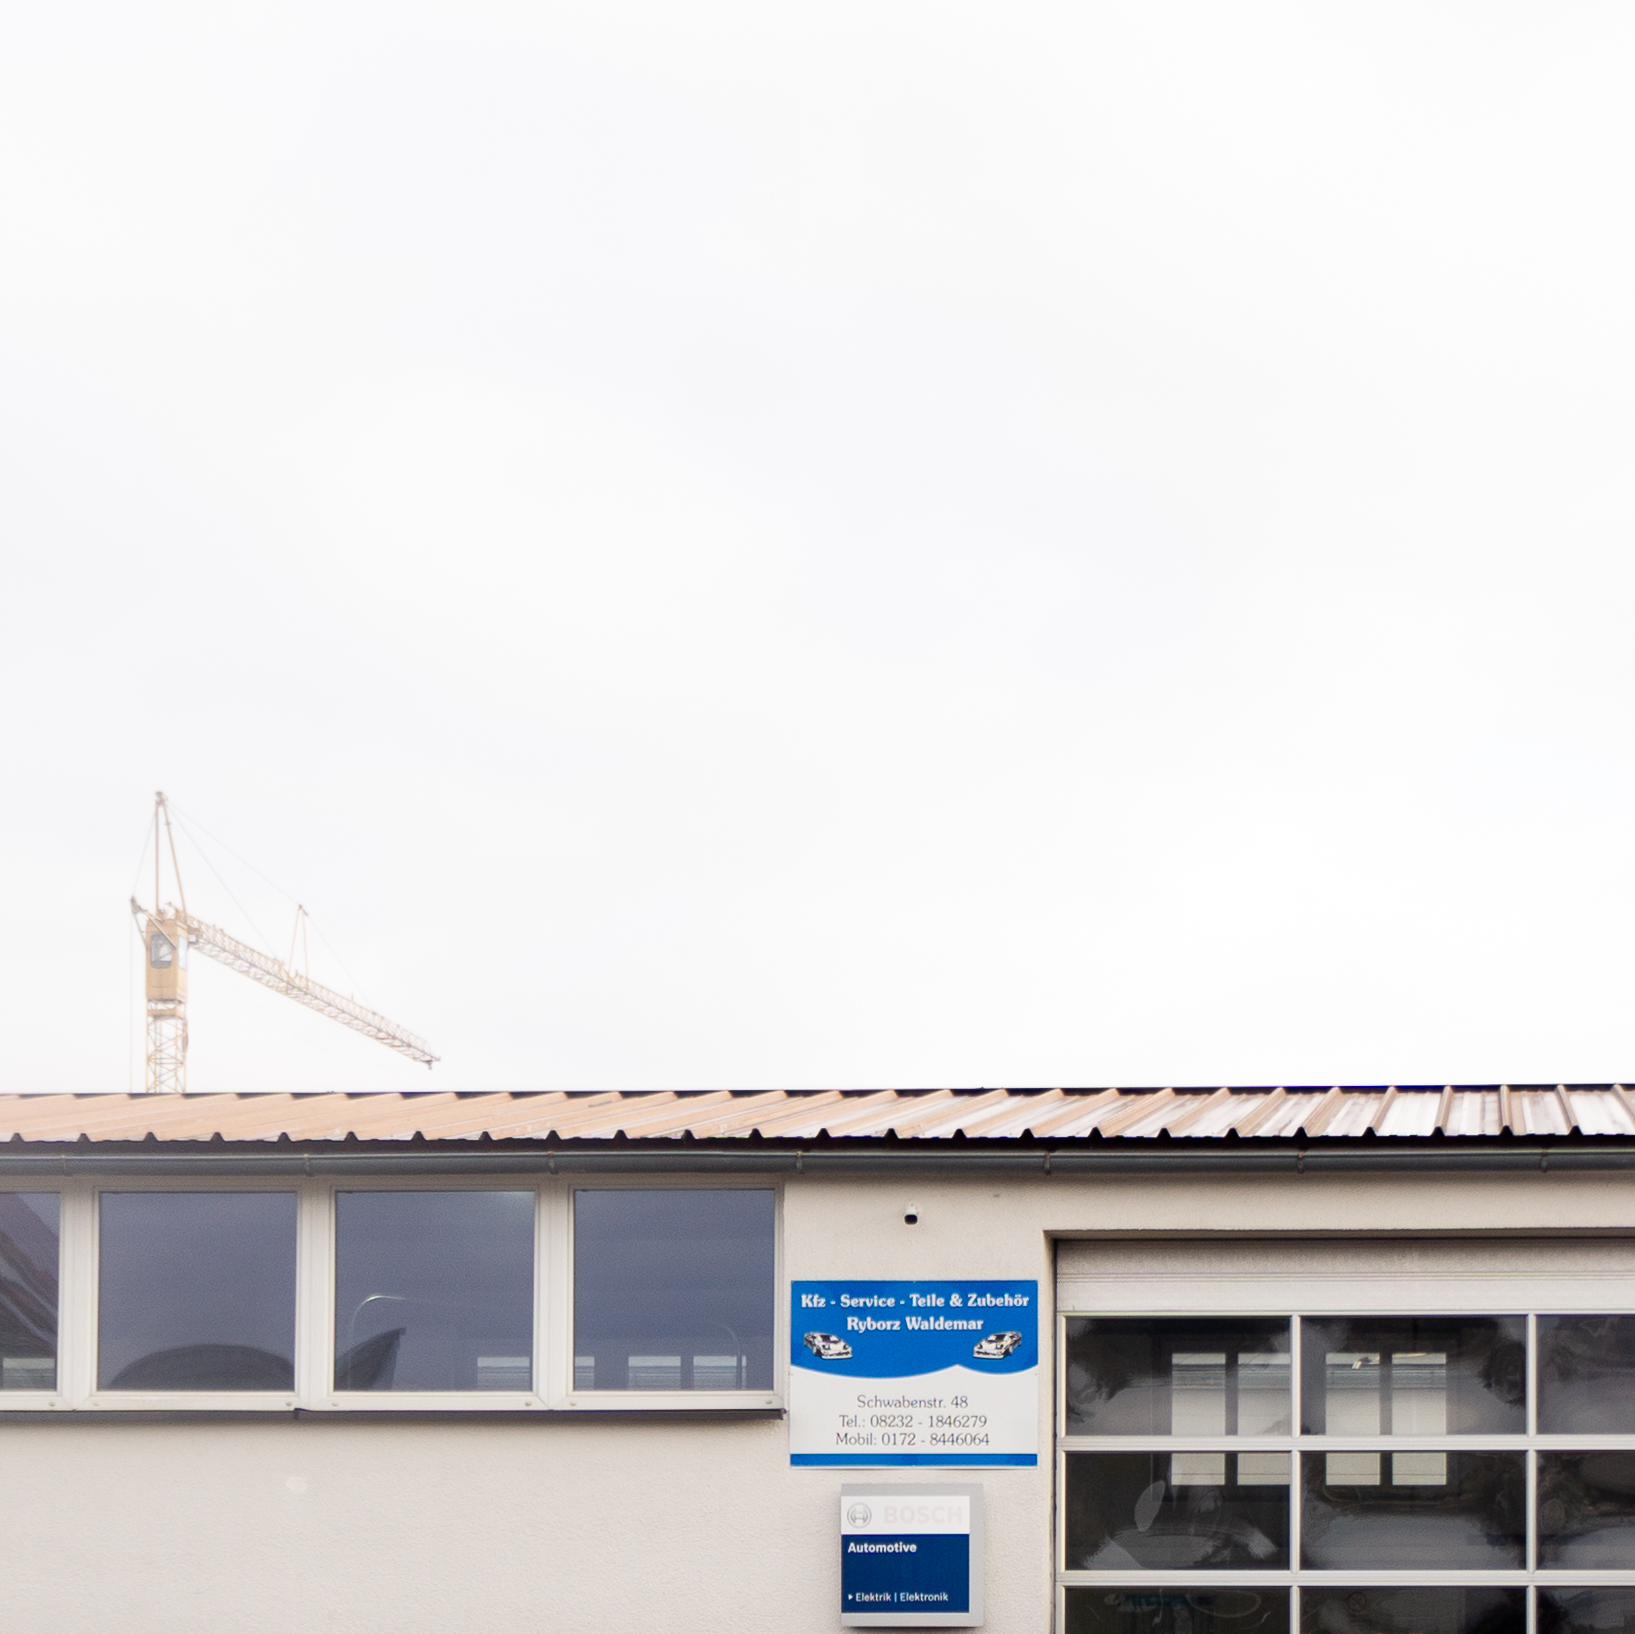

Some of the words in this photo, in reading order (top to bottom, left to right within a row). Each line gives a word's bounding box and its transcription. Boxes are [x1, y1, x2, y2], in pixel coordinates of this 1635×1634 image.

[800, 1293, 826, 1308] Kfz
[840, 1293, 895, 1308] Service
[909, 1293, 945, 1308] Teile
[949, 1294, 963, 1307] &
[968, 1293, 1030, 1308] Zubehör
[846, 1316, 901, 1334] Ryborz
[906, 1316, 984, 1331] Waldemar
[856, 1395, 946, 1409] Schwabenstr.
[951, 1395, 969, 1409] 48
[839, 1414, 866, 1428] Tel.:
[870, 1414, 913, 1428] 08232
[928, 1414, 988, 1428] 1846279
[836, 1432, 877, 1446] Mobil:
[881, 1432, 916, 1446] 0172
[929, 1432, 990, 1446] 8446064
[883, 1506, 962, 1525] BOSCH
[847, 1542, 917, 1554] Automotive
[855, 1592, 892, 1602] Elektrik
[899, 1592, 949, 1602] Elektronik
